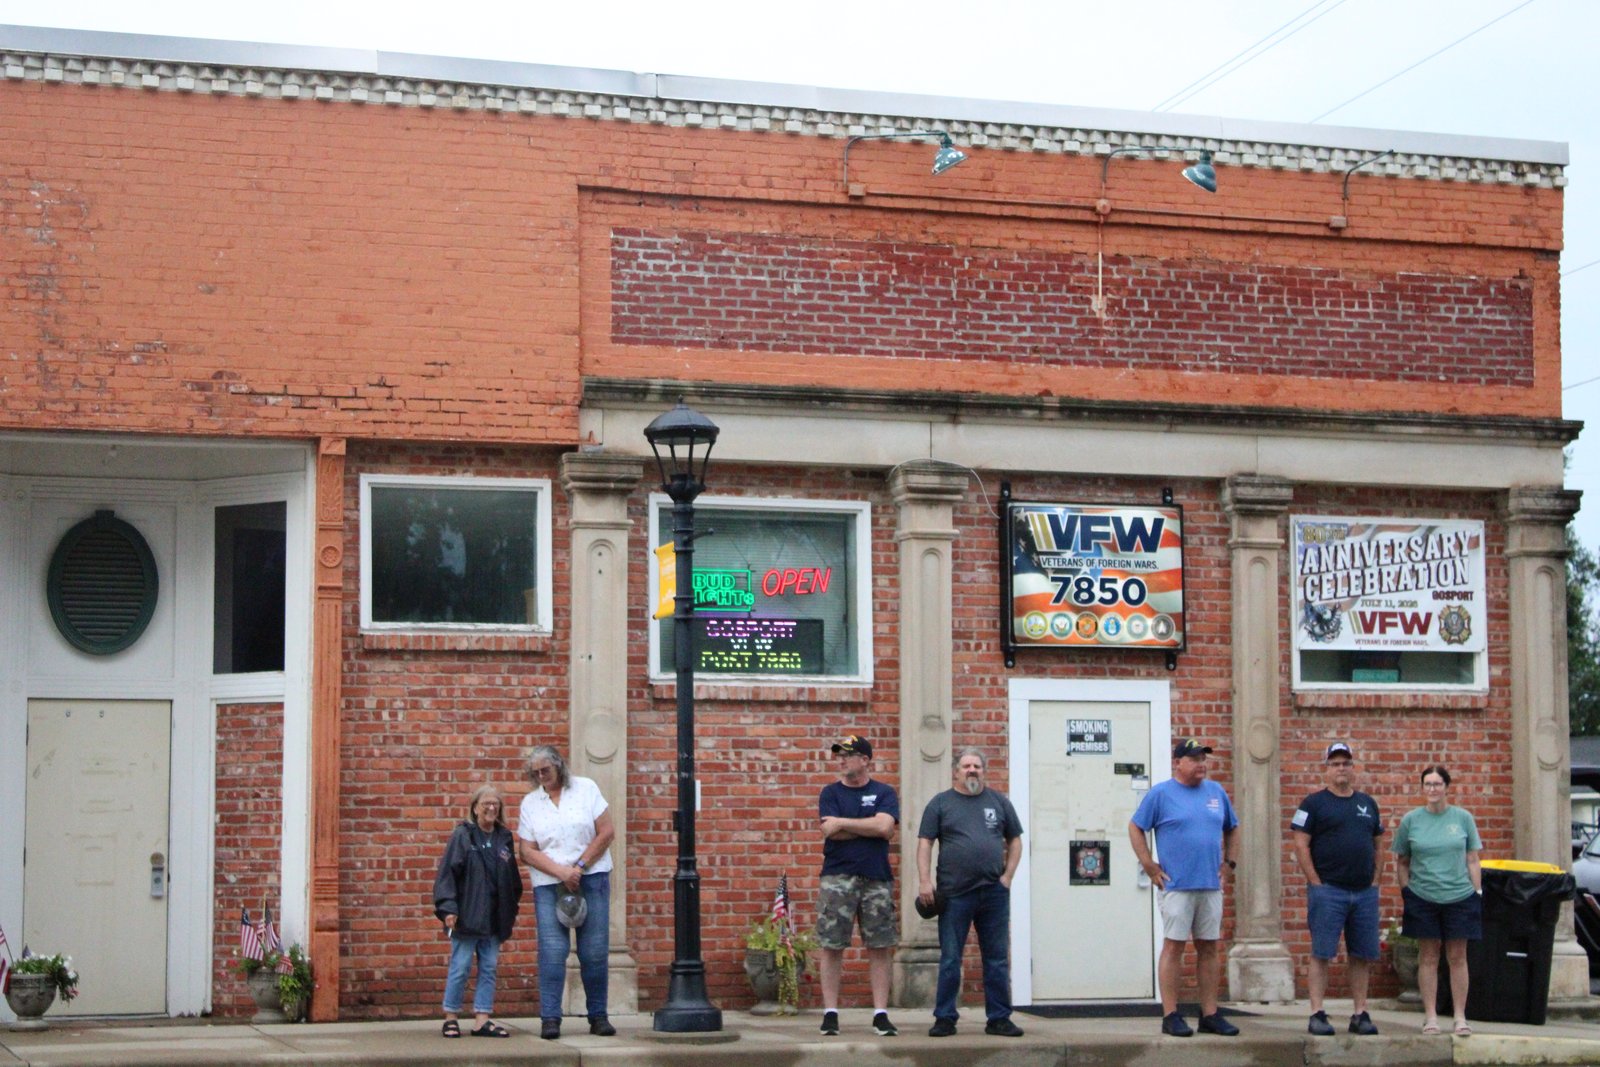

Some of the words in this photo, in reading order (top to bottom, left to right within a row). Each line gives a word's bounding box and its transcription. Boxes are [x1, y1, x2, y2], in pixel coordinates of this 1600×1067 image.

[1047, 514, 1165, 553] VFW
[1301, 530, 1473, 575] ANNIVERSARY
[1042, 557, 1084, 568] VETERANS
[1086, 558, 1096, 568] OF
[1098, 559, 1132, 569] FOREIGN
[692, 573, 736, 590] BUD
[762, 567, 832, 597] OPEN
[1303, 557, 1471, 604] CELEBRATION
[1050, 576, 1147, 606] 7850
[1432, 590, 1474, 601] GOSPORT
[1360, 599, 1382, 608] JULY
[1358, 611, 1433, 636] VFW
[1070, 720, 1108, 733] SMOKING
[1084, 734, 1095, 742] ON
[1070, 742, 1109, 752] PREMISES
